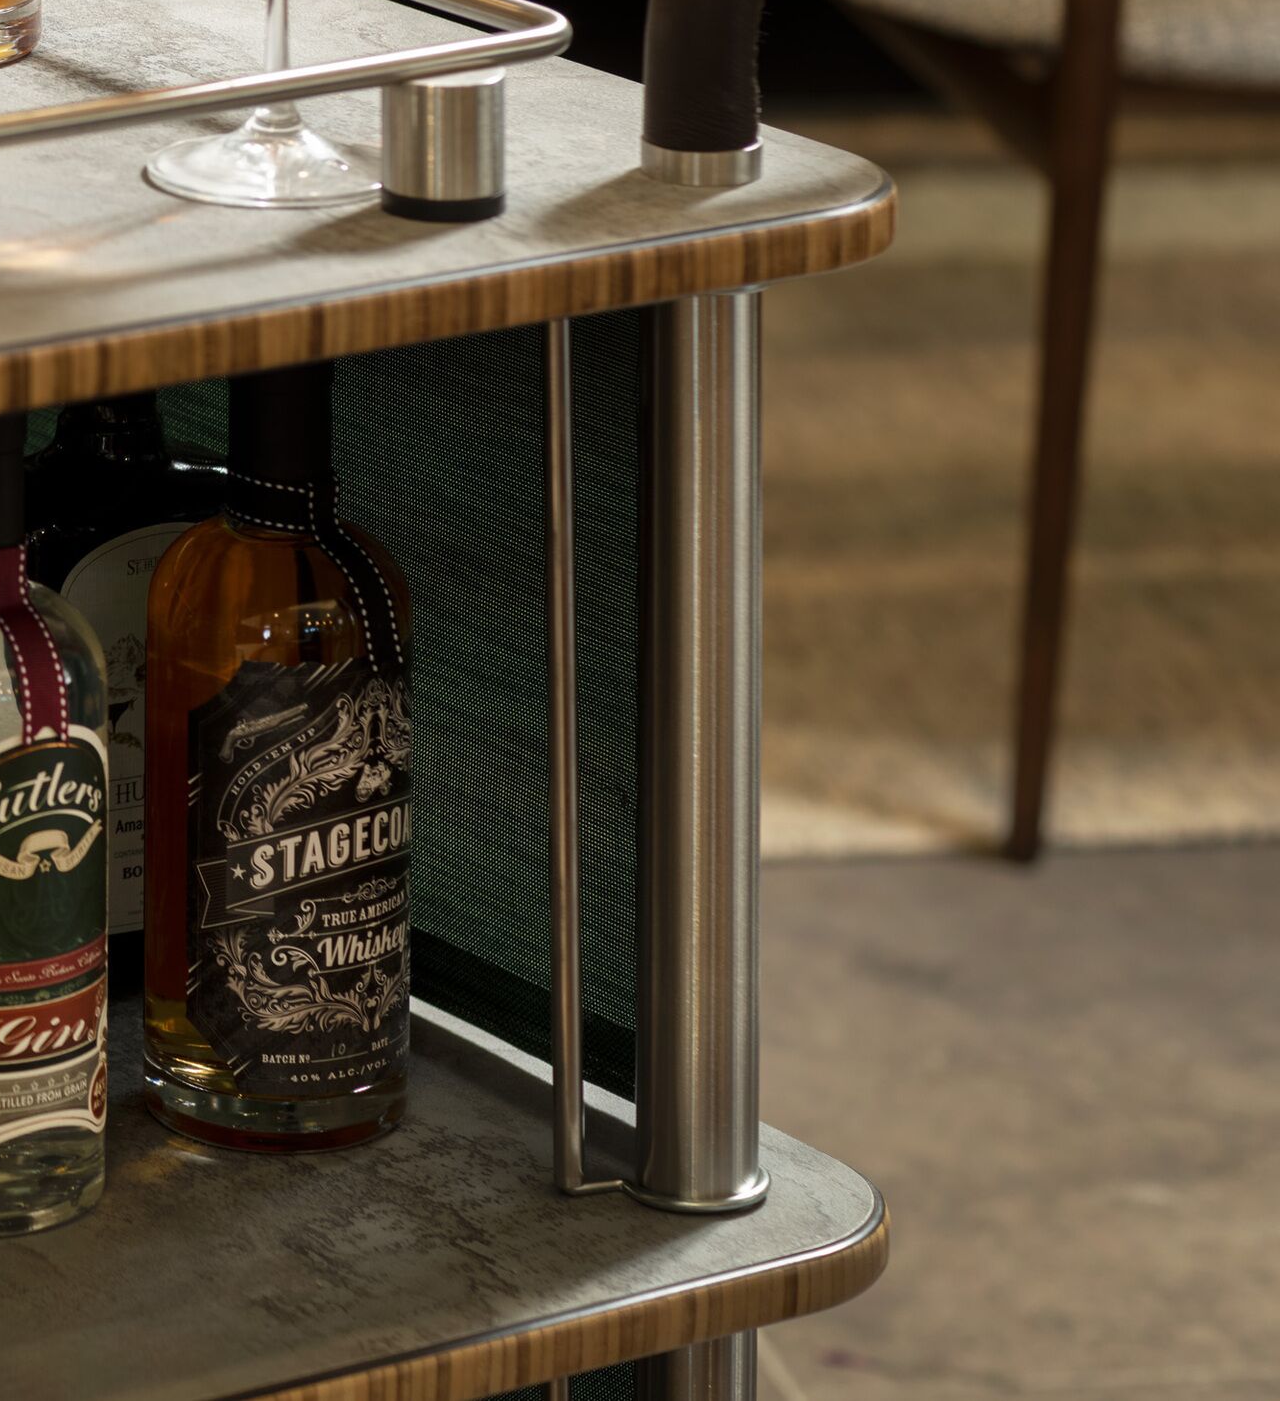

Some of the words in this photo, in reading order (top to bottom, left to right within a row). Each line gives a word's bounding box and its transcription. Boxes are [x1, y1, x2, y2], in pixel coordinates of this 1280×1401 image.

[230, 761, 262, 796] HOLD
[265, 742, 293, 761] 'EM
[296, 727, 317, 744] UP
[115, 819, 144, 835] Ama
[249, 801, 411, 890] STAGECOA
[322, 910, 358, 928] TRUE
[317, 920, 407, 968] Whiskey
[261, 1054, 296, 1064] BATCH
[371, 1037, 389, 1051] DATE
[290, 1070, 321, 1083] 40%
[36, 1090, 62, 1104] FROM
[63, 1078, 88, 1098] GRAIN
